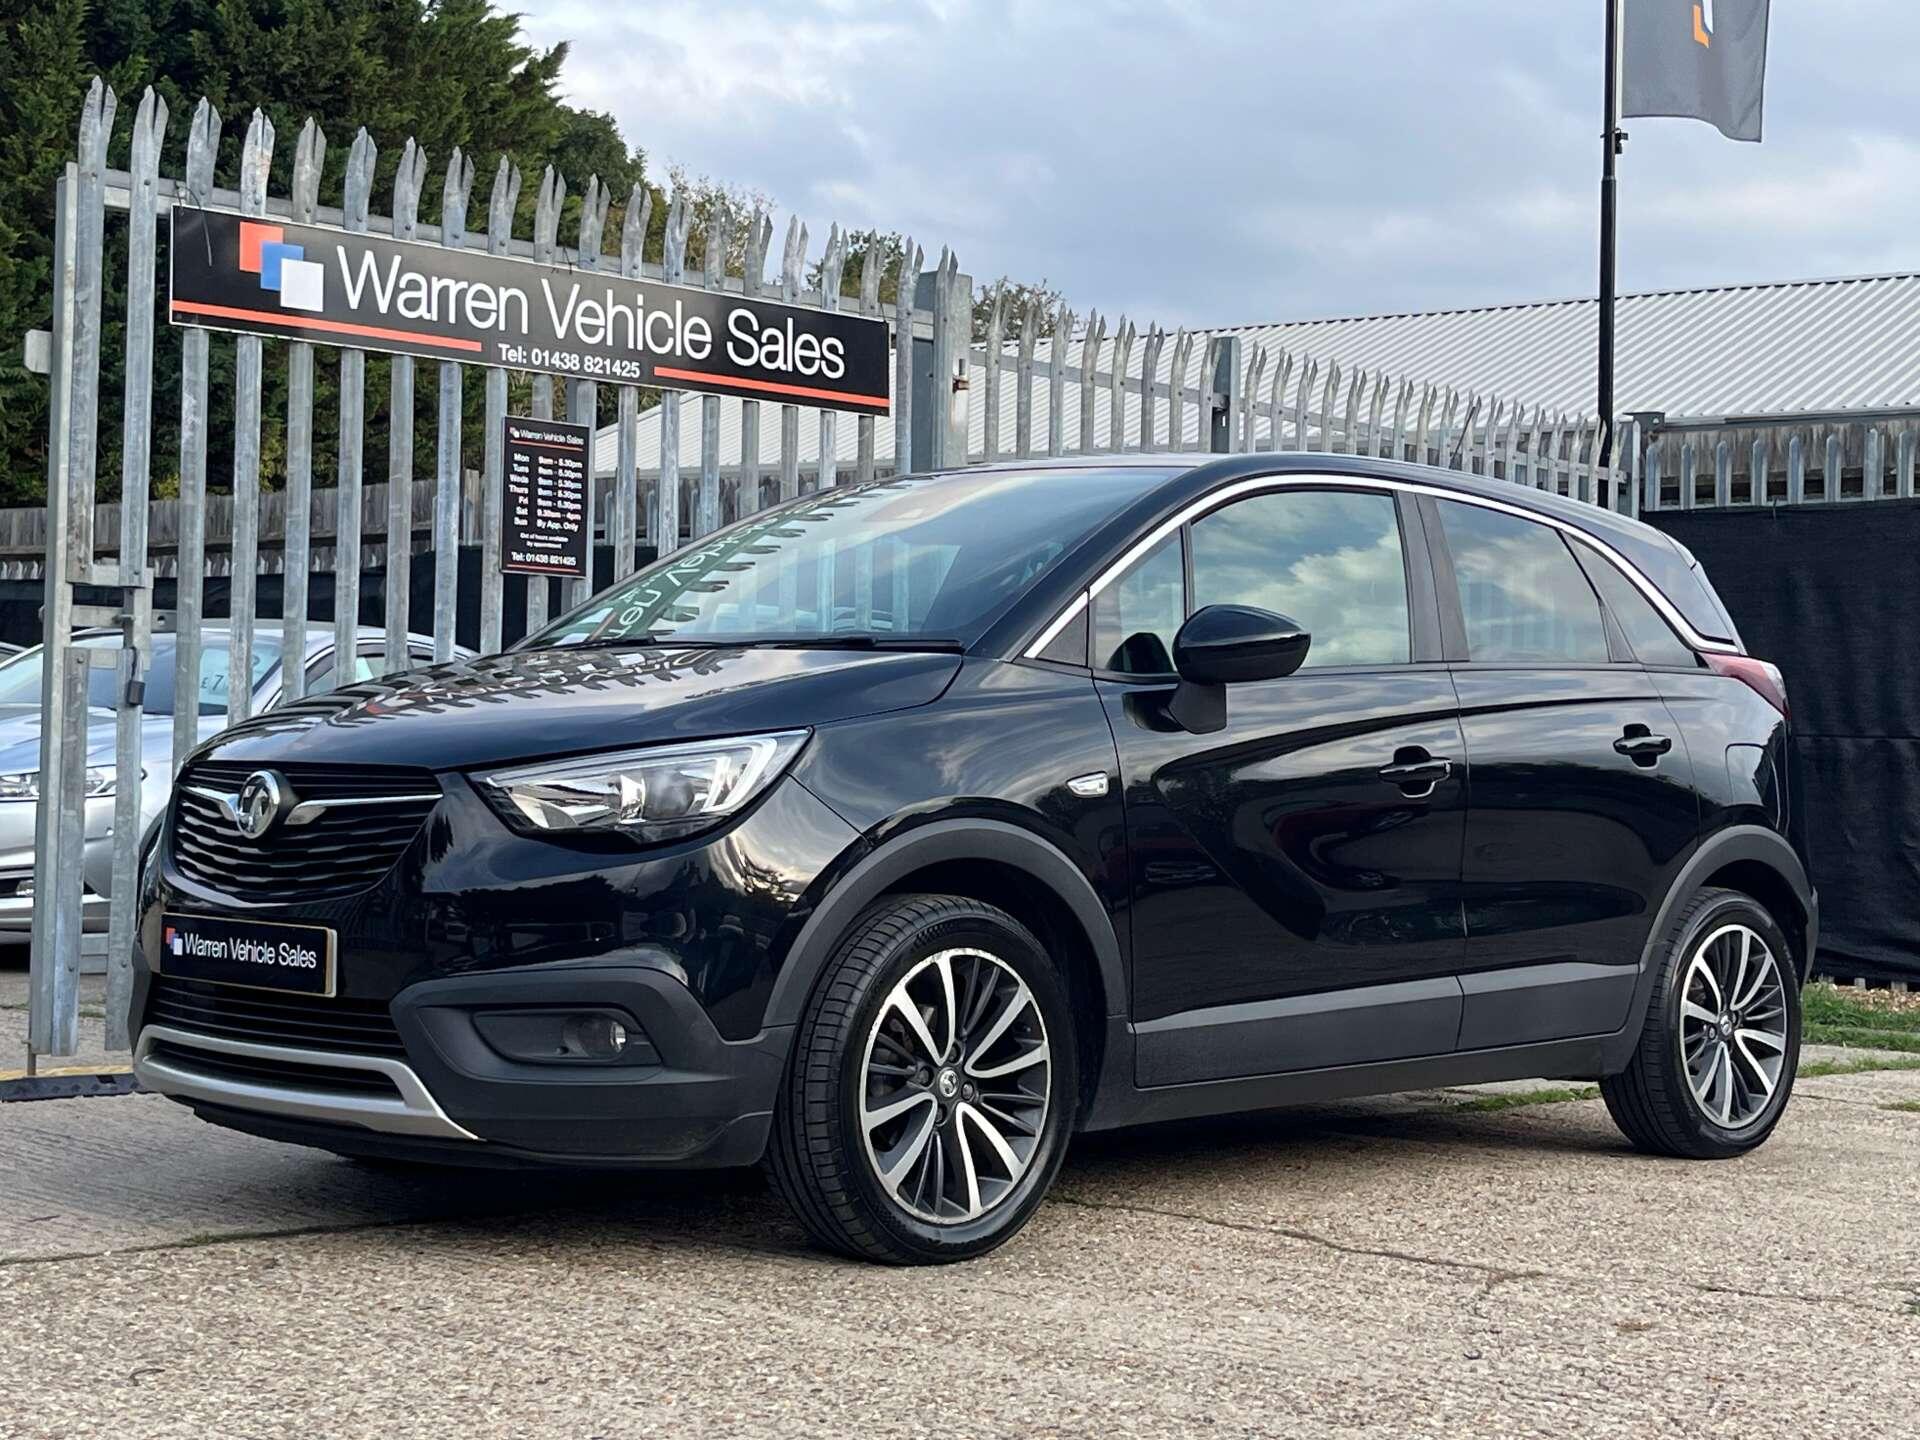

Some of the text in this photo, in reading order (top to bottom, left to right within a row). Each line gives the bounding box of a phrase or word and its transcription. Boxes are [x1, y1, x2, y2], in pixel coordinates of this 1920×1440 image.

[336, 245, 846, 379] Warren Vehicle Sales
[497, 343, 641, 379] Tel: 01438 821425
[519, 429, 584, 445] Warren Vehicle Sales
[513, 453, 530, 463] Mon
[515, 506, 528, 516] Sat
[514, 517, 528, 526] Sun
[536, 519, 546, 529] By
[562, 521, 579, 532] Only
[511, 551, 526, 562] Tel:
[525, 552, 549, 564] 01438
[184, 931, 317, 969] Warren Vehicle Sales
